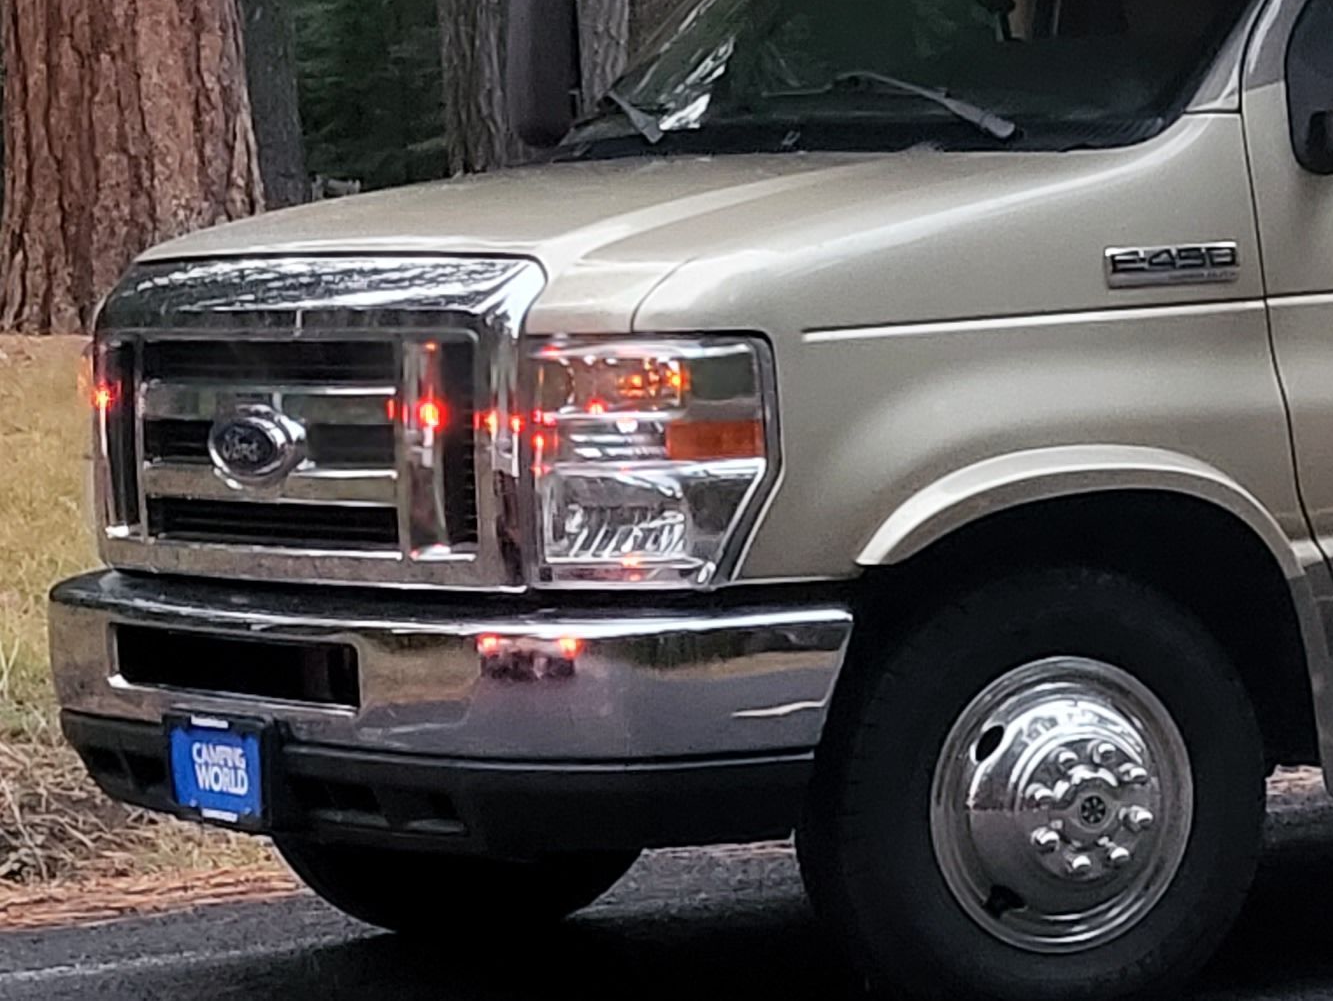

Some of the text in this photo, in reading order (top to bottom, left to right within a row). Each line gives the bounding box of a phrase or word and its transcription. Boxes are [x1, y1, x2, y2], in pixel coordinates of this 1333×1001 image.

[222, 426, 260, 463] Ford
[192, 741, 247, 769] CAMPING
[195, 763, 249, 796] WORLD
